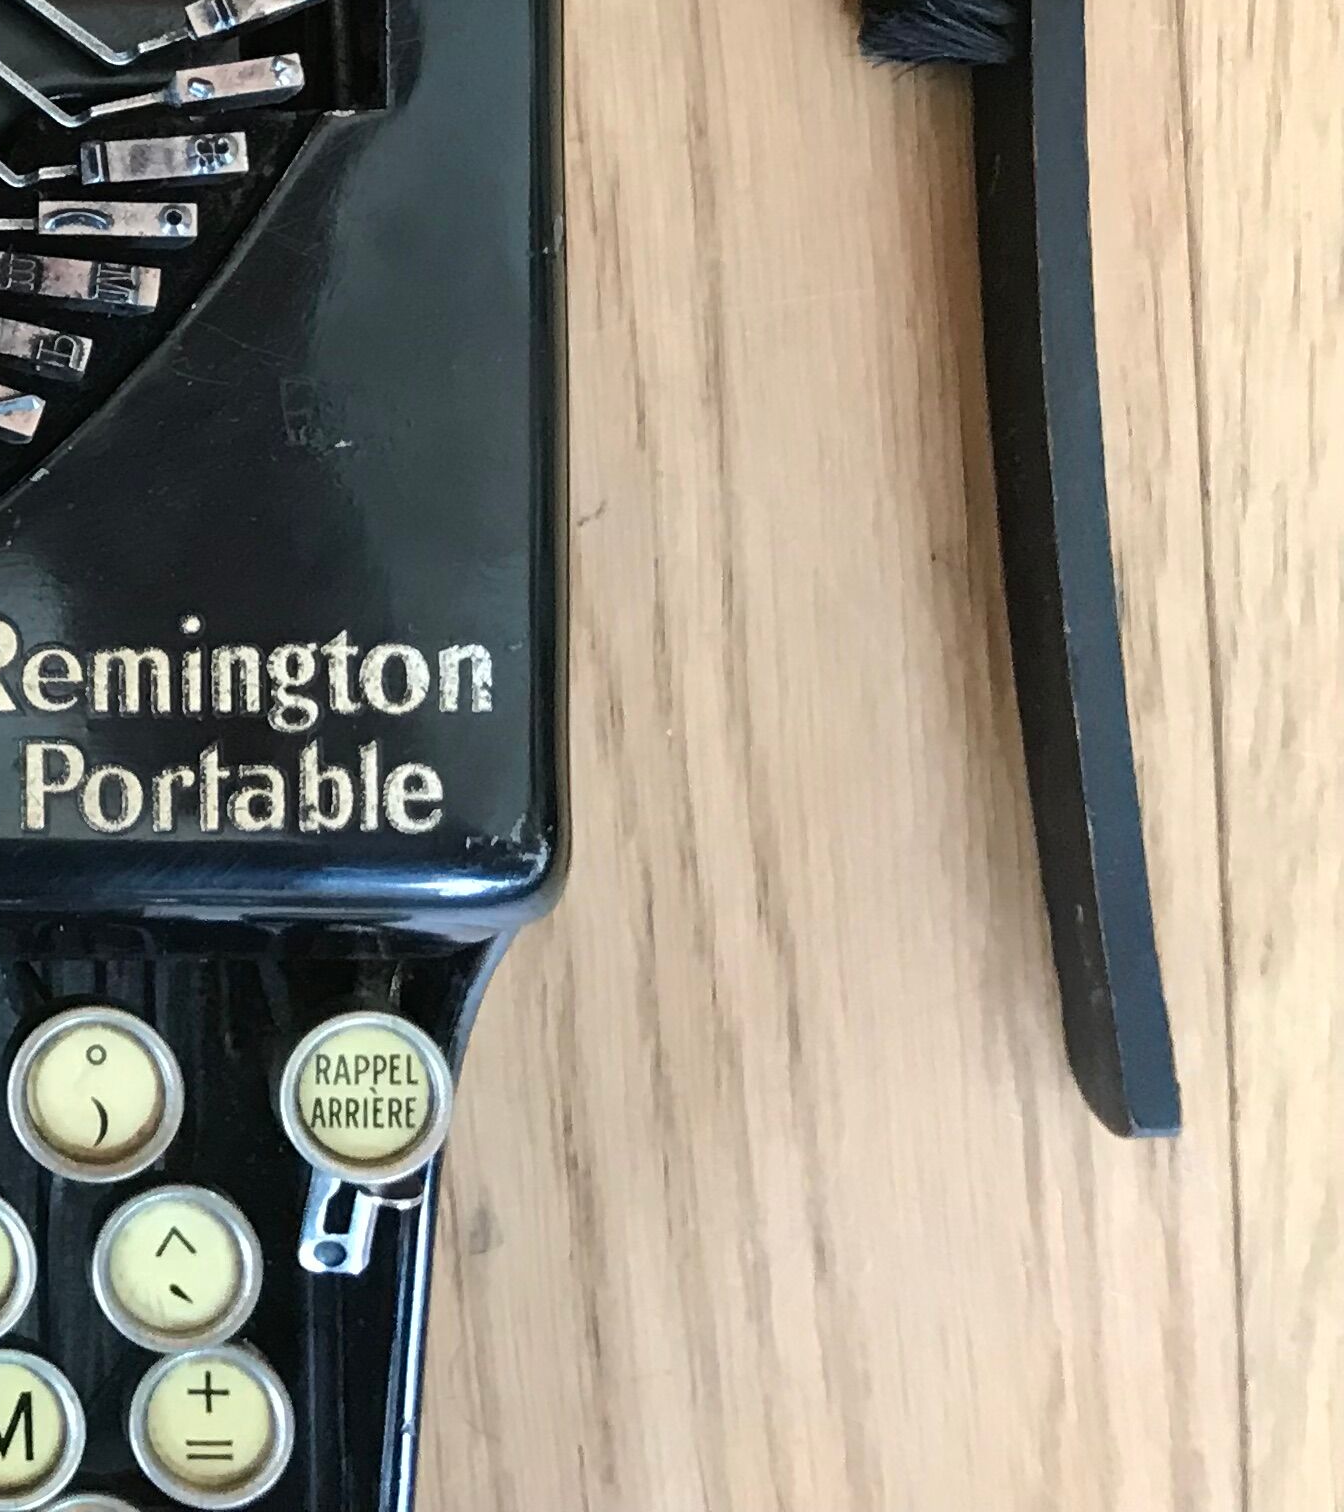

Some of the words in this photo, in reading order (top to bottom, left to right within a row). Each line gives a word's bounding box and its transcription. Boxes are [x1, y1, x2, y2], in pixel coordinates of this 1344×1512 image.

[20, 738, 444, 833] Portable
[314, 1053, 420, 1087] RAPPEL
[93, 1096, 110, 1147] )
[310, 1087, 416, 1130] ARRIÈRE
